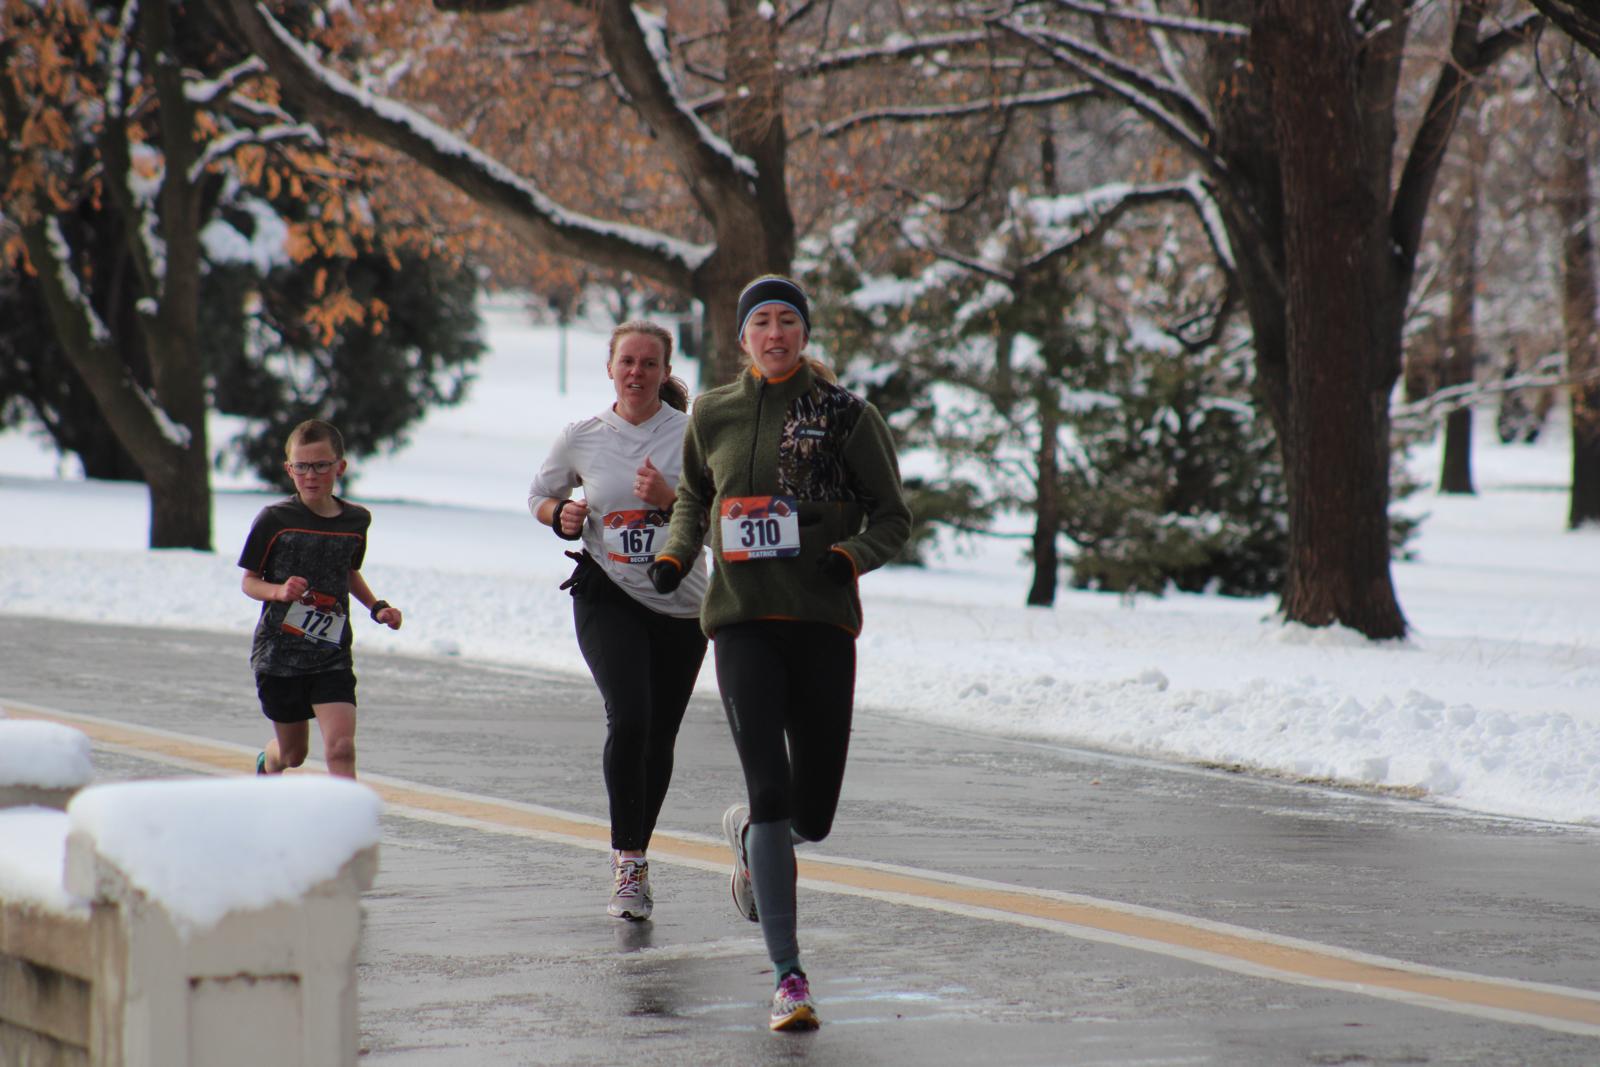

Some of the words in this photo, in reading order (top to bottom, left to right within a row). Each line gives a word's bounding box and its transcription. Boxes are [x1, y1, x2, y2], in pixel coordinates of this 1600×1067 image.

[620, 528, 655, 554] 167
[740, 519, 781, 548] 310
[301, 610, 333, 637] 172
